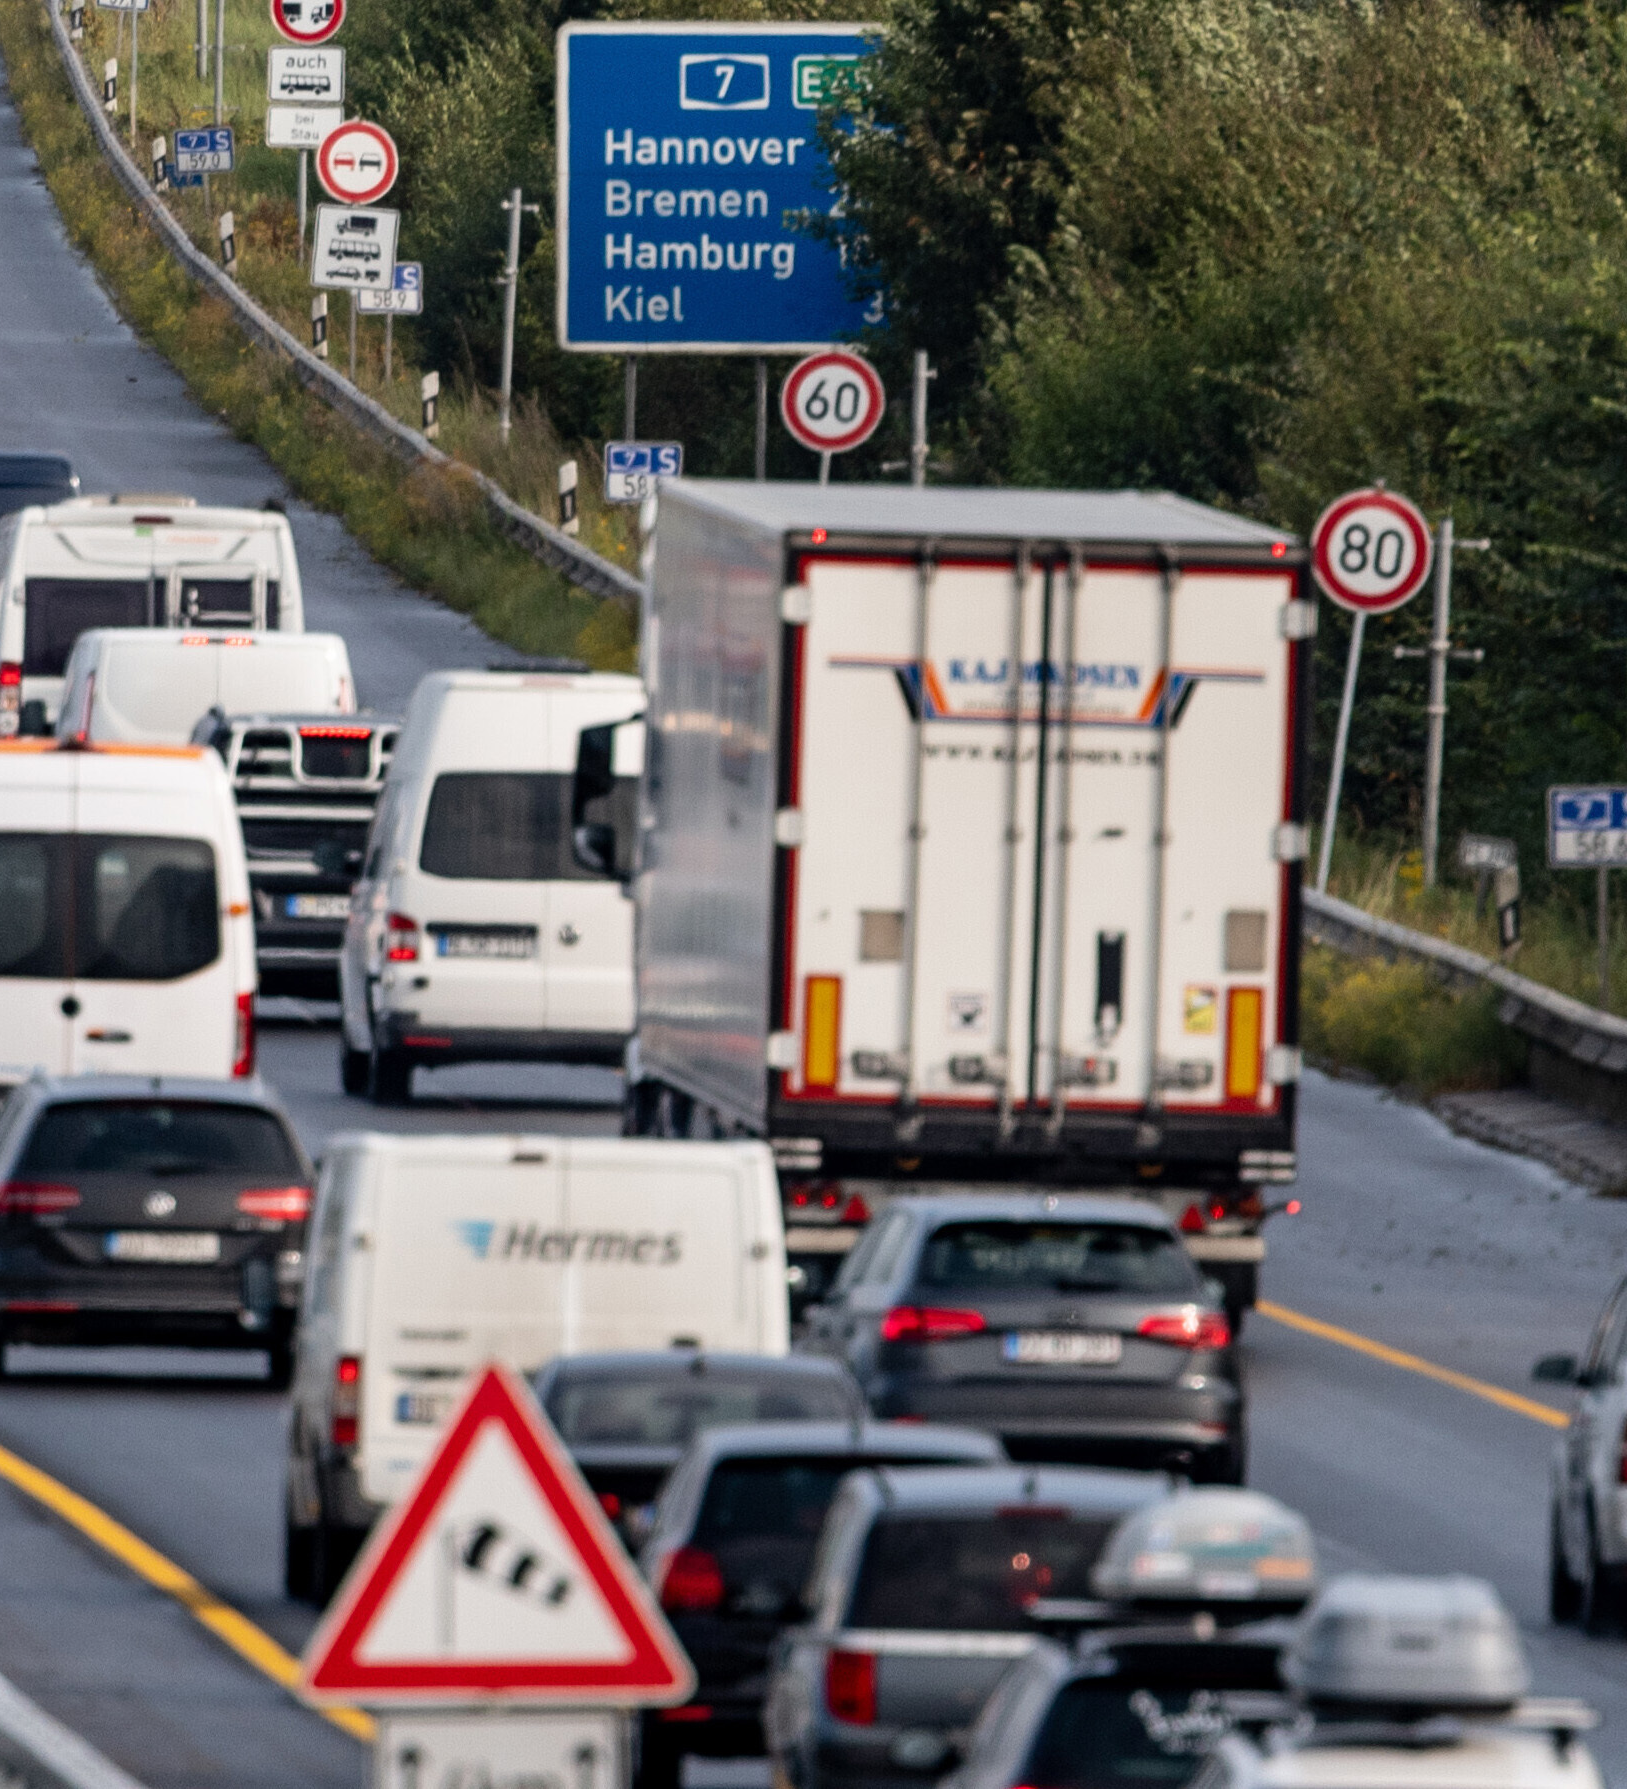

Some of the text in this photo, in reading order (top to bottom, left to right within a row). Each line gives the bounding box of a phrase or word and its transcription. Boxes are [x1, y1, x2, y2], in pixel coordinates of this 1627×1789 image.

[286, 54, 326, 69] auch
[715, 65, 735, 98] 7
[291, 127, 320, 141] Stau
[295, 112, 314, 125] bei
[189, 131, 229, 150] 7 S
[605, 128, 805, 165] Hannover
[606, 179, 769, 217] Bremen
[605, 234, 796, 280] Hamburg
[401, 267, 418, 290] S
[605, 286, 685, 322] Kiel
[804, 379, 861, 424] 60
[622, 446, 677, 475] 7 S
[1339, 523, 1404, 579] 80
[501, 1218, 684, 1266] Hermes
